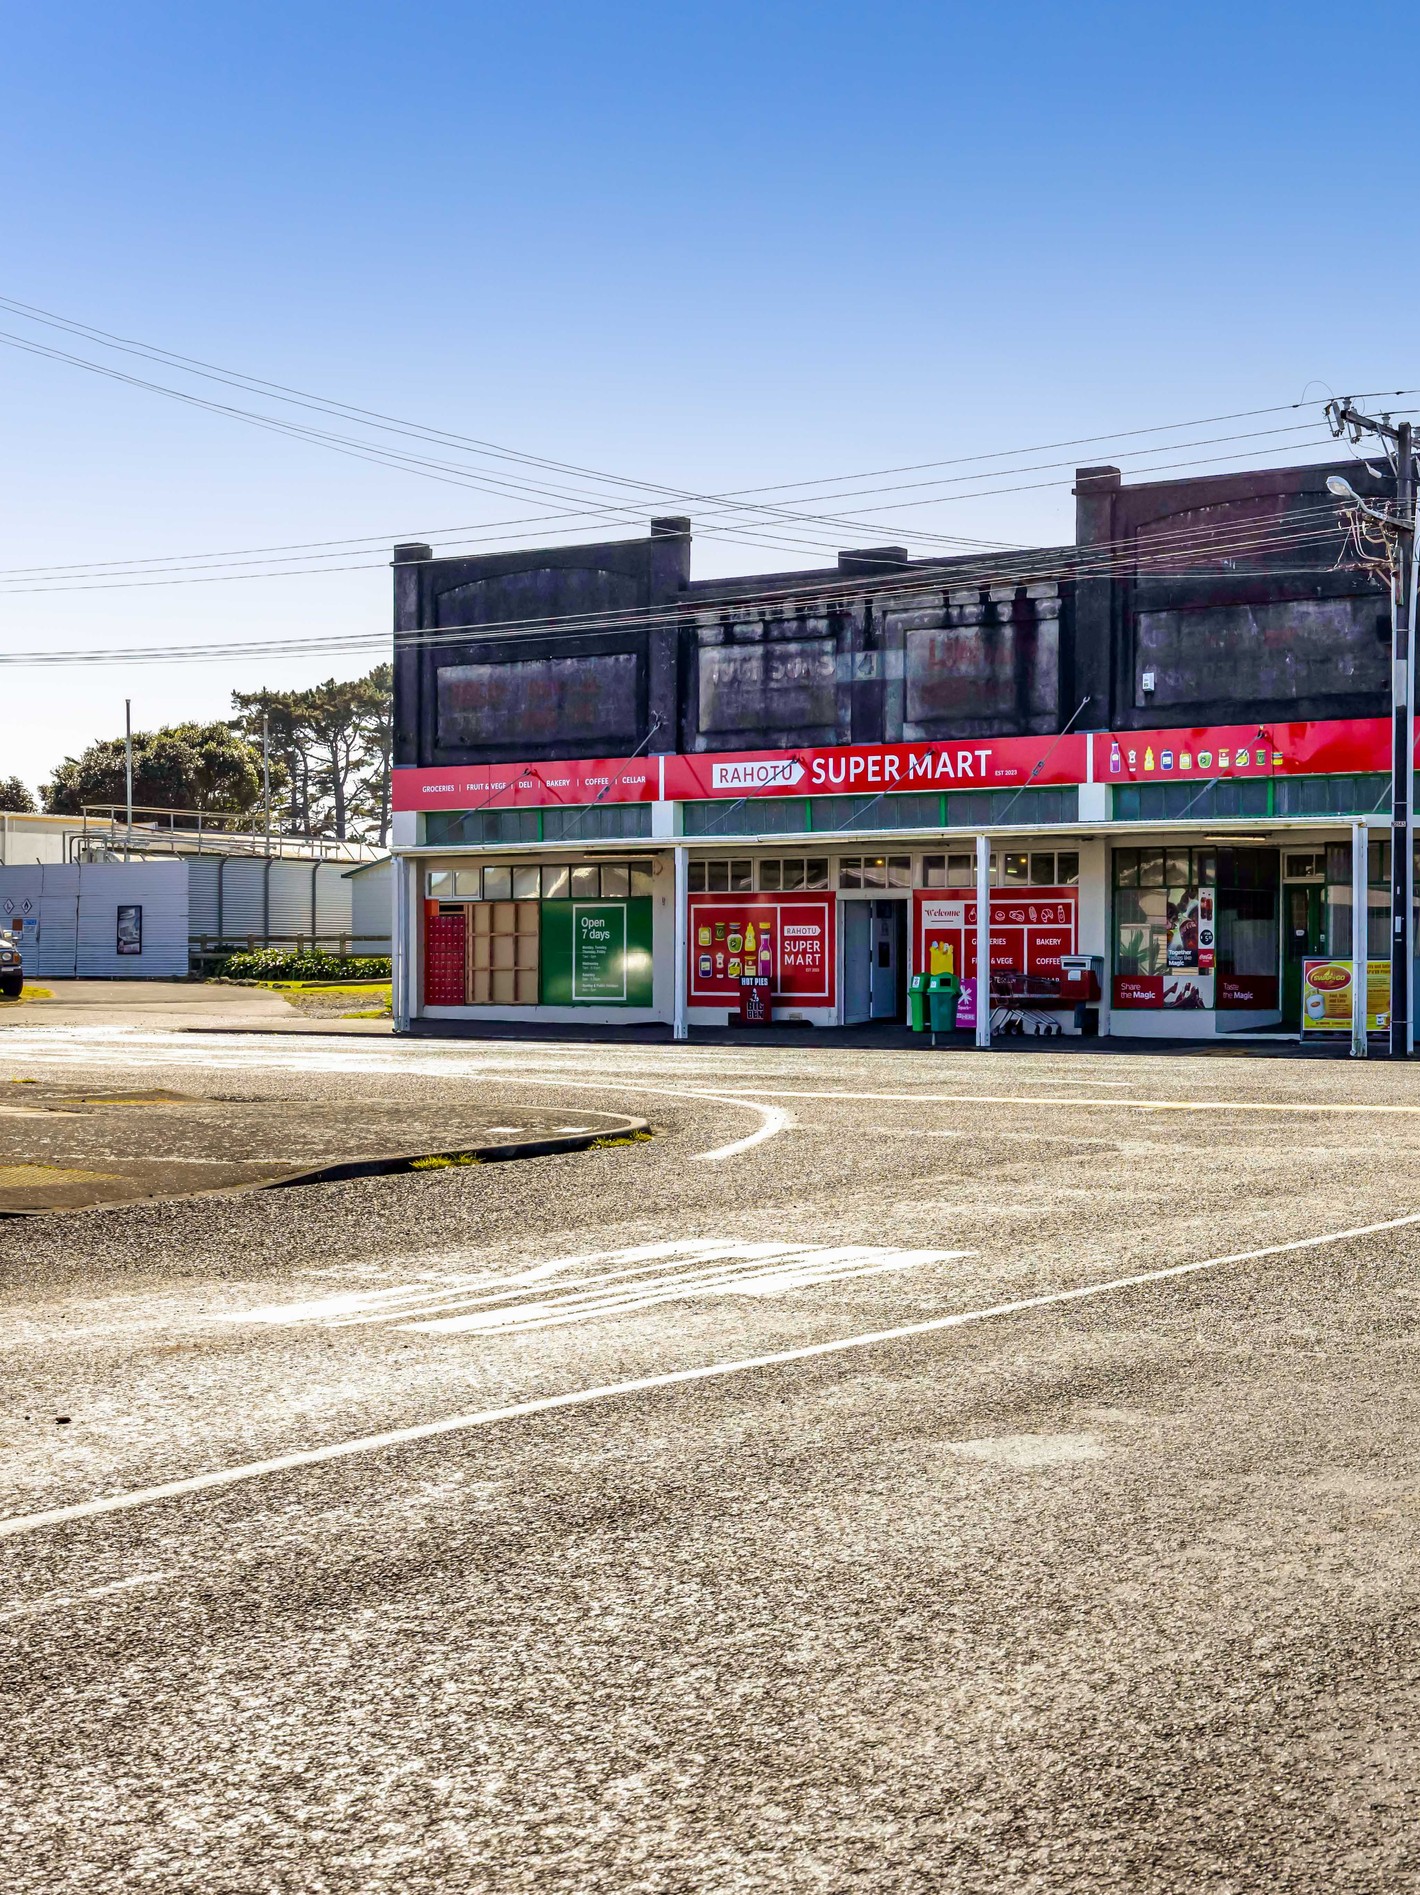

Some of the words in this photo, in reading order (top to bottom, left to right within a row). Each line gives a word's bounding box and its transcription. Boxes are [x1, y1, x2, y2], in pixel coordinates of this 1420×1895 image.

[720, 765, 793, 783] RAHOTU
[811, 754, 900, 784] SUPER
[908, 749, 992, 780] MART
[546, 779, 570, 787] BAKERY
[584, 777, 609, 786] COFFEE
[622, 775, 646, 784] CELLAR
[422, 784, 455, 793] GROCERIES
[466, 783, 484, 791] FRUIT
[518, 781, 533, 789] DELI
[924, 908, 961, 917] Welcome
[581, 916, 605, 929] Open
[582, 929, 588, 939] 7
[589, 929, 610, 941] days
[786, 927, 817, 935] RAHOTU
[784, 940, 821, 952] SUPER
[784, 954, 821, 965] MART
[990, 957, 996, 965] &
[996, 957, 1013, 965] VEGE
[1036, 957, 1061, 965] COFFEE
[741, 977, 753, 986] HOT
[754, 977, 769, 986] PIES
[1120, 982, 1141, 991] Share
[1223, 982, 1240, 991] Taste
[1120, 991, 1132, 999] the
[1132, 991, 1155, 1000] Magic
[1222, 991, 1233, 999] the
[1233, 991, 1254, 1000] Magic
